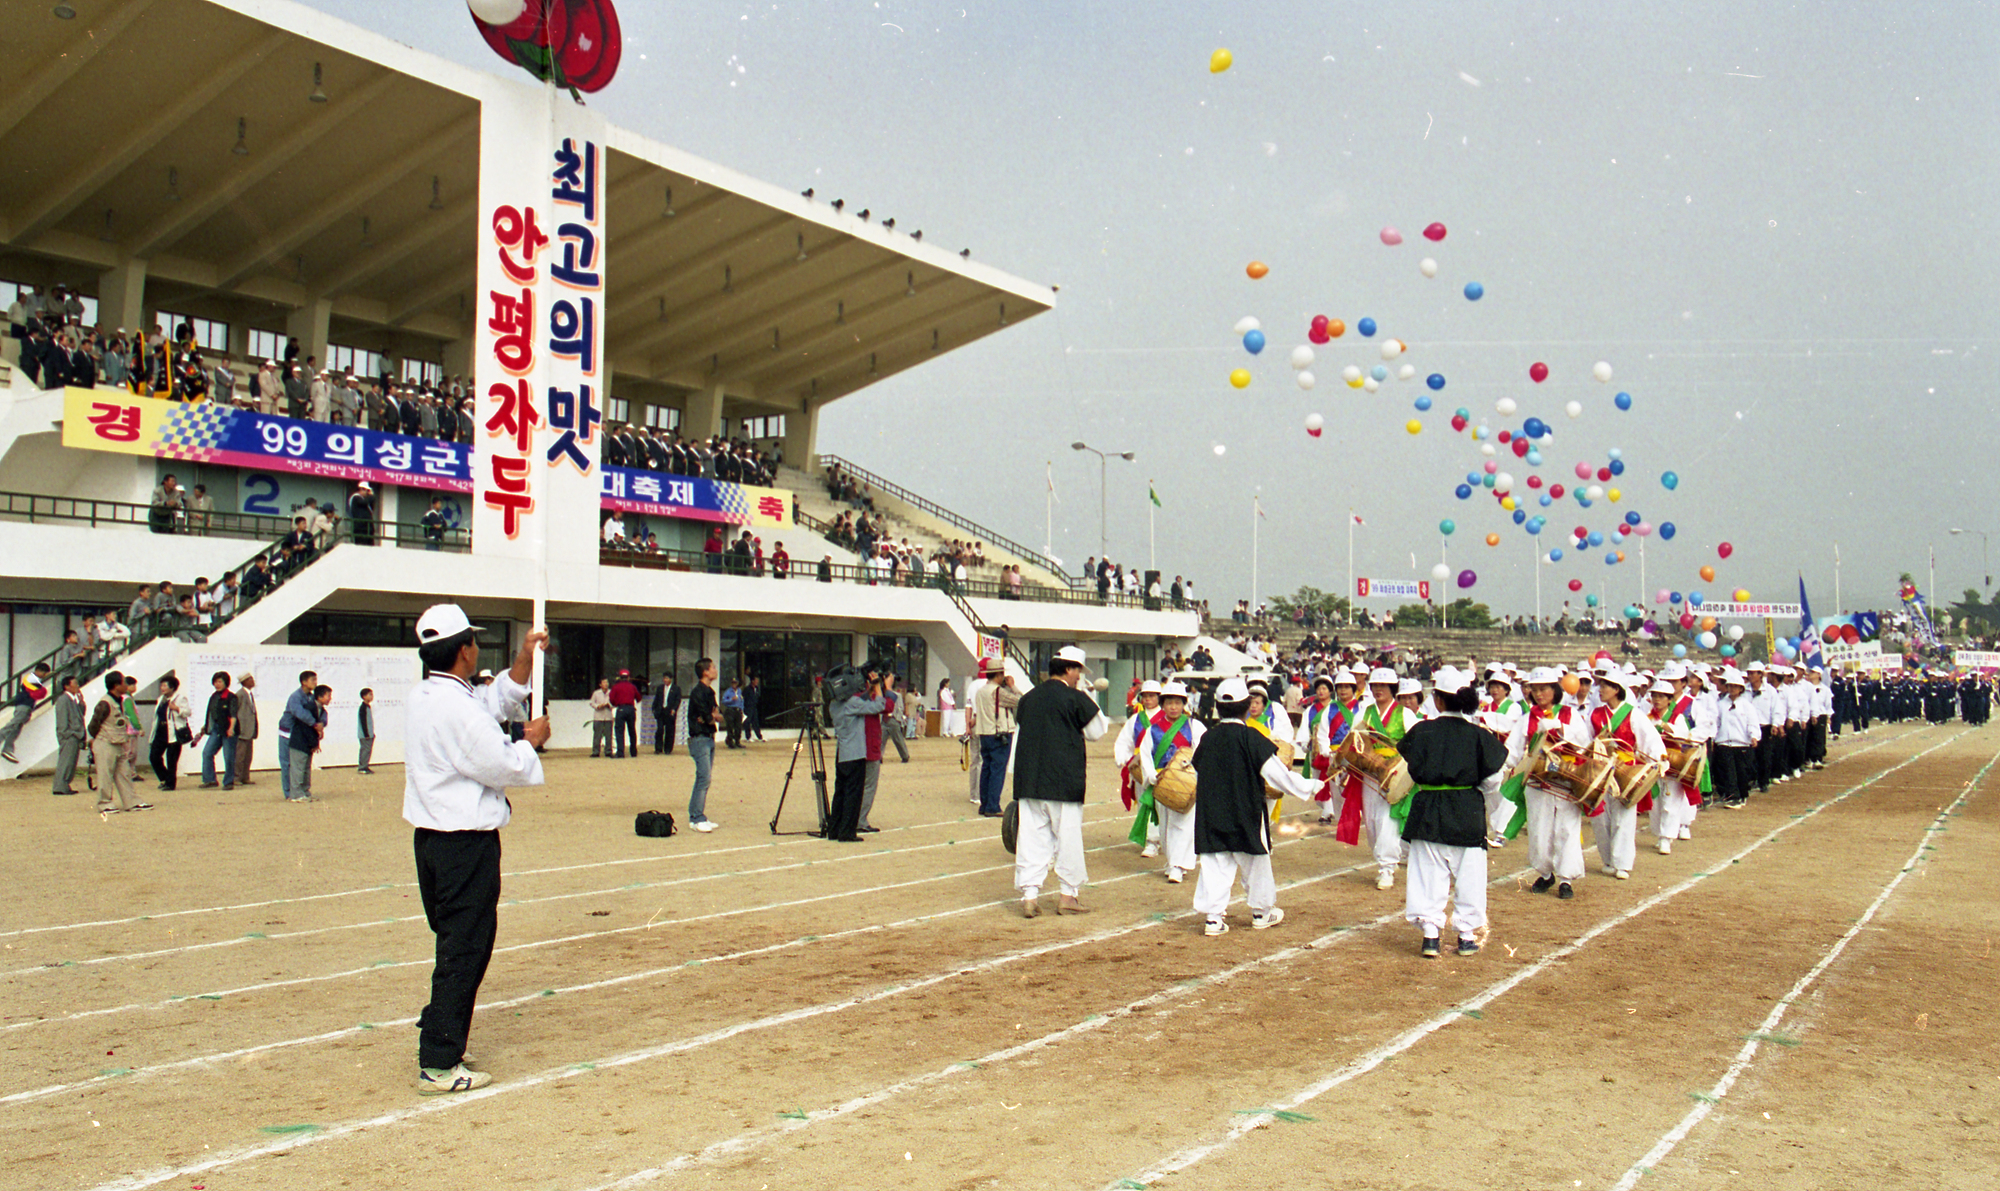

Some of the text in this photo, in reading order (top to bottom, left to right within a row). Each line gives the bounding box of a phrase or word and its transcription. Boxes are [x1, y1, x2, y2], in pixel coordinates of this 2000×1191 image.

[484, 205, 549, 536] 안평자두
[87, 402, 141, 441] 경
[255, 420, 307, 456] '99
[325, 433, 474, 479] 의성군
[244, 473, 280, 515] 2
[757, 496, 784, 522] 축
